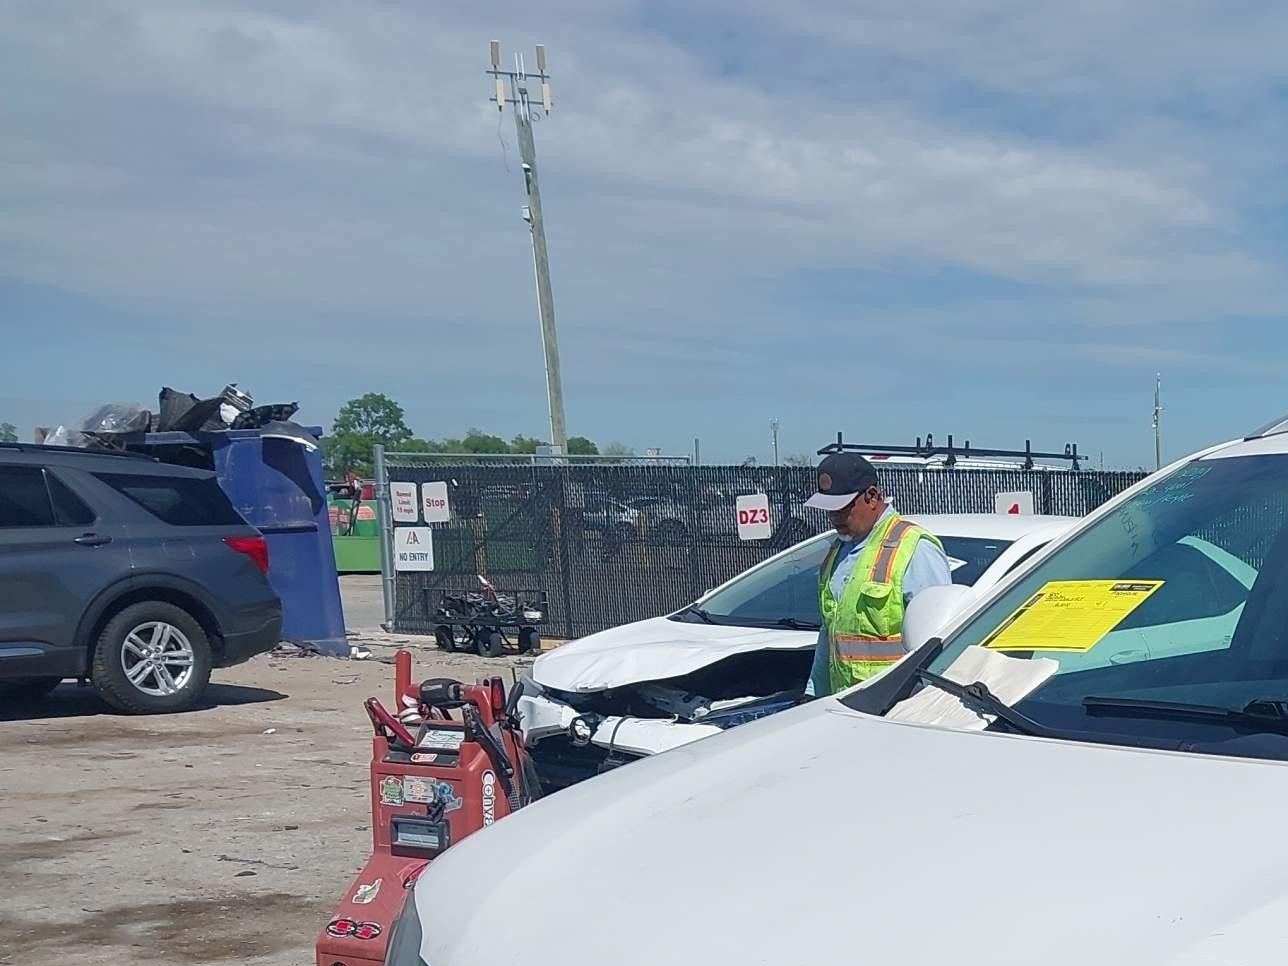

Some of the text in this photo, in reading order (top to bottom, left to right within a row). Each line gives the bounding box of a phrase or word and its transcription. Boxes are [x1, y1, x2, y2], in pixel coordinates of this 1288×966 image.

[426, 498, 445, 509] Stop
[739, 509, 768, 524] DZ3
[400, 553, 428, 561] NO ENTRY
